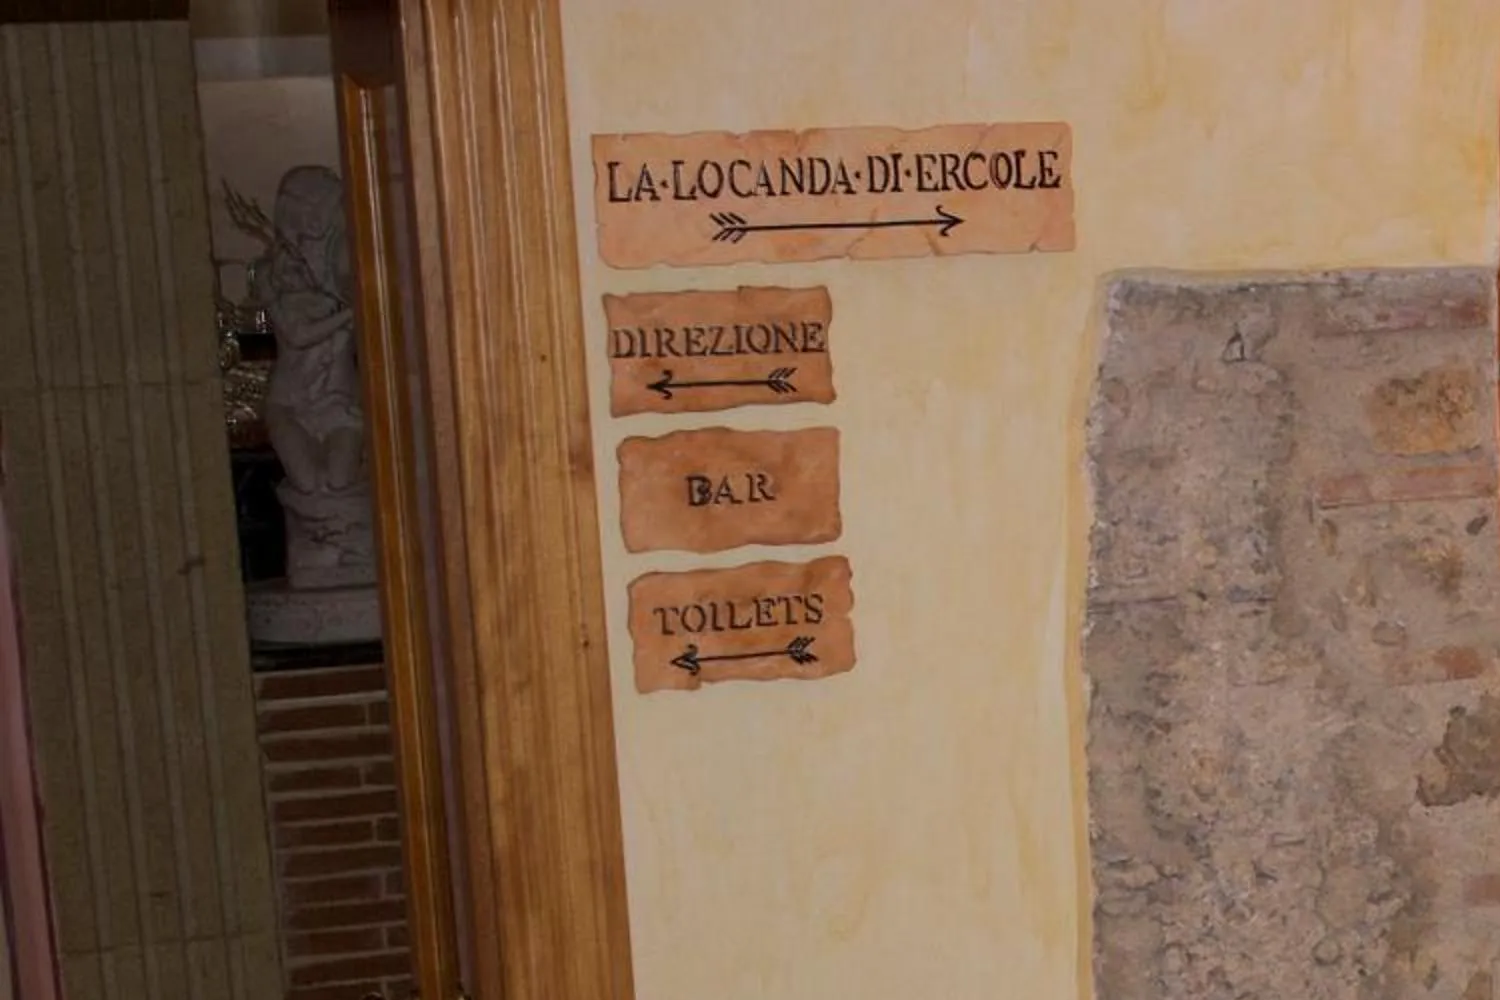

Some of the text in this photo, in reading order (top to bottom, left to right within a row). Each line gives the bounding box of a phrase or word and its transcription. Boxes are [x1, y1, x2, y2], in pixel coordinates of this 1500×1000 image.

[611, 321, 827, 359] DIREZIONE
[685, 473, 777, 507] BAR
[652, 593, 825, 637] TOILETS
